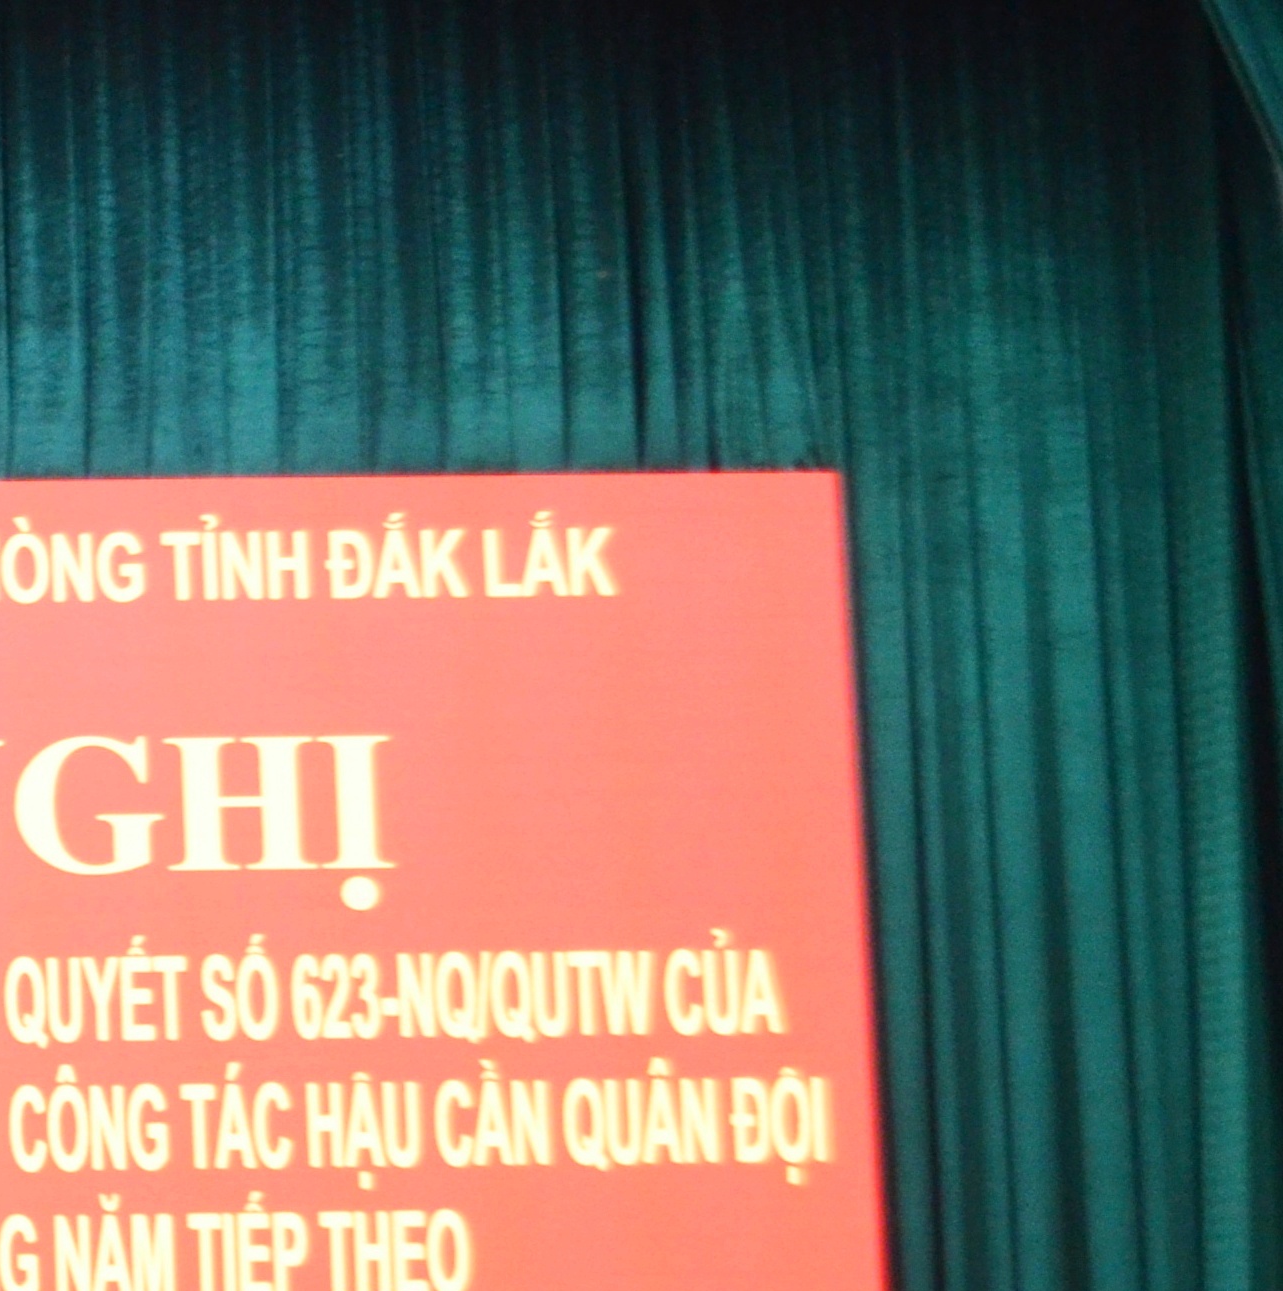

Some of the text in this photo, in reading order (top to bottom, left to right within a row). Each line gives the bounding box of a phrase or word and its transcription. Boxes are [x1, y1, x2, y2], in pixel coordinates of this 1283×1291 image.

[159, 513, 311, 601] TỈNH
[325, 510, 468, 600] ĐẮK
[483, 509, 617, 598] LẮK
[3, 934, 188, 1049] QUYẾT
[200, 933, 279, 1042] SỐ
[291, 949, 652, 1044] 623-NQ/QUTW
[664, 929, 786, 1036] CỦA
[9, 1064, 169, 1174] CÔNG
[180, 1061, 293, 1170] TÁC
[306, 1071, 421, 1190] HẬU
[435, 1058, 551, 1168] CẦN
[564, 1056, 720, 1171] QUÂN
[730, 1068, 829, 1185] ĐỘI
